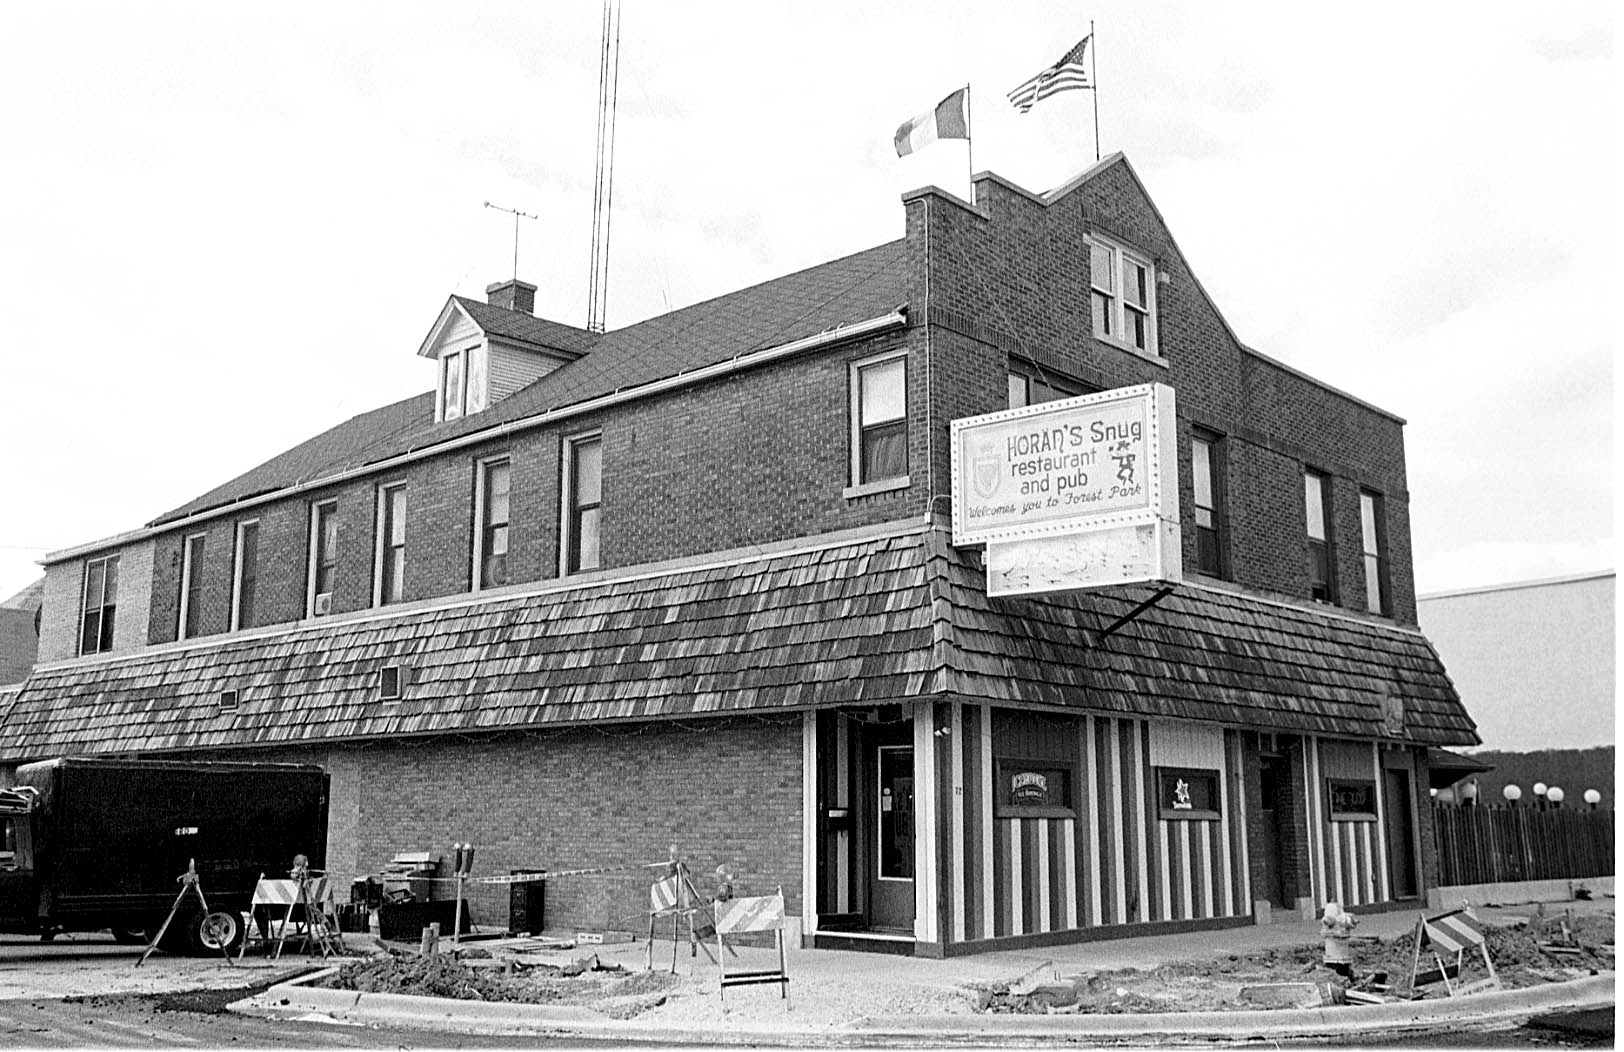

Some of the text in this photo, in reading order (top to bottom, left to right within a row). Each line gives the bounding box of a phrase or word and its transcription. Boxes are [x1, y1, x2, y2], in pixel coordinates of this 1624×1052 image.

[1090, 420, 1142, 443] Snug
[1011, 447, 1097, 477] restaurant
[1020, 468, 1088, 496] and pub
[968, 483, 1142, 518] Welcomes you to Forest Park
